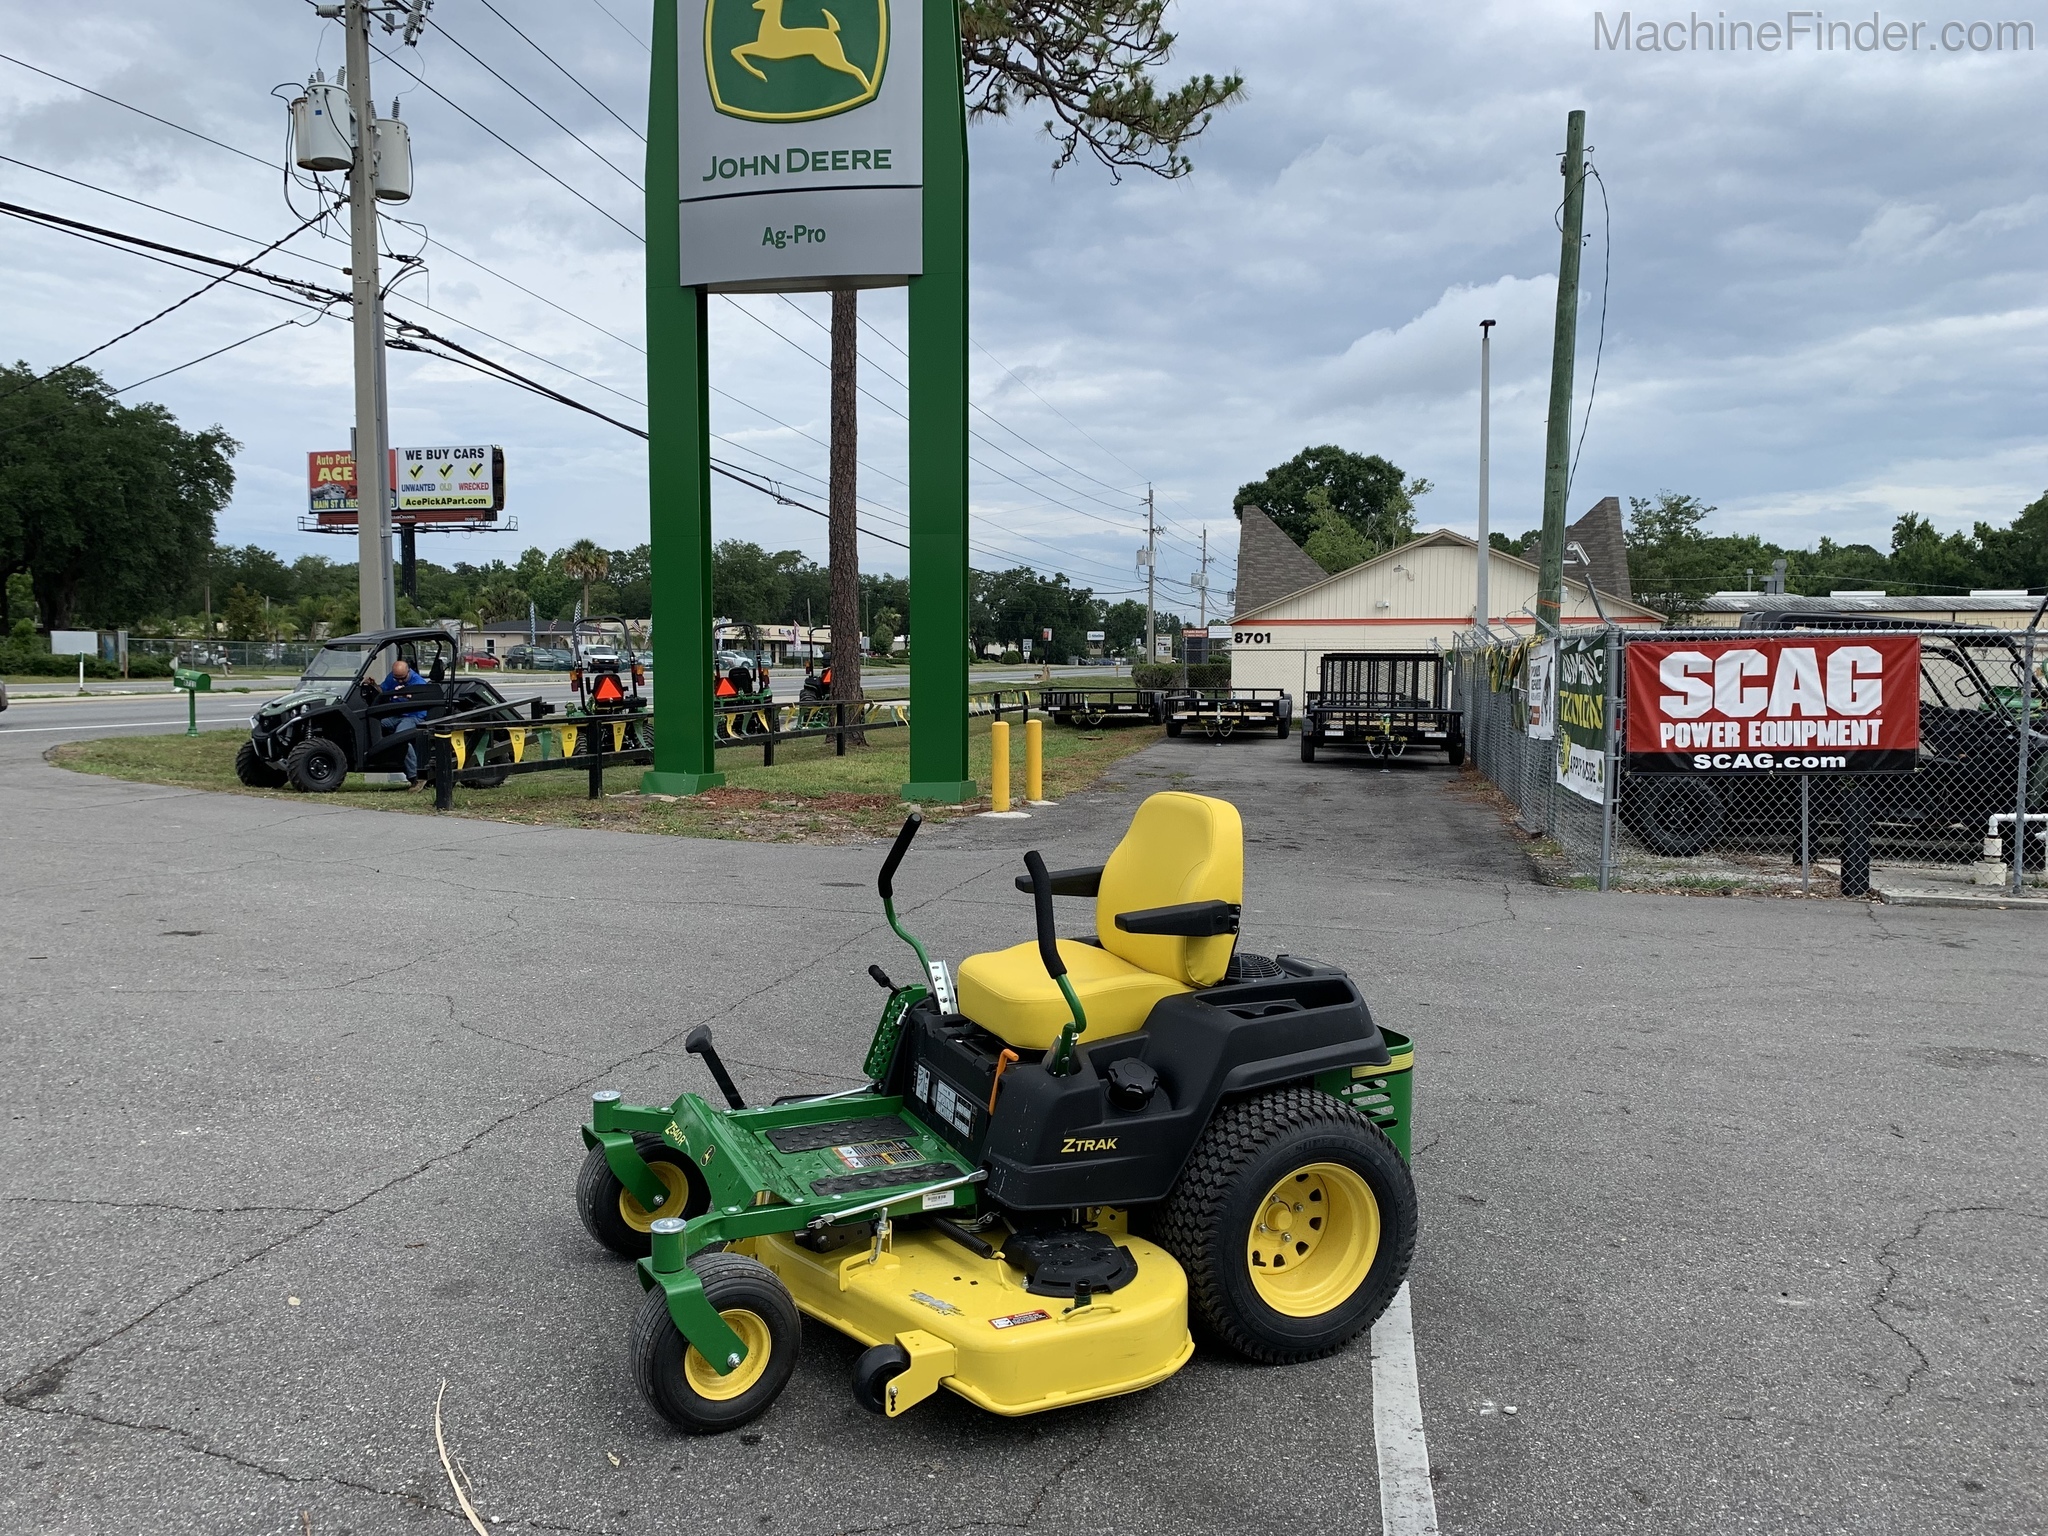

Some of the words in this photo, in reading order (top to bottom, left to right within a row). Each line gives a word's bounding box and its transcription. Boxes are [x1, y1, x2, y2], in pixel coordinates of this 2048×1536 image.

[702, 153, 780, 182] JOHN
[786, 147, 892, 173] DEERE
[761, 224, 827, 249] Ag-Pro
[316, 454, 333, 465] Auto
[405, 449, 422, 460] WE
[426, 449, 449, 460] BUY
[453, 448, 485, 459] CARS
[317, 466, 353, 481] ACE
[401, 483, 436, 492] UNWANTED
[439, 482, 452, 491] OLD
[458, 482, 490, 491] WRECKED
[313, 499, 329, 509] MAIN
[405, 497, 487, 506] AcePickAPart.com
[1234, 632, 1271, 643] 8701
[1659, 646, 1883, 718] SCAG
[1660, 721, 1741, 749] POWER
[1748, 719, 1883, 747] EQUIPMENT
[1693, 753, 1846, 769] SCAG.com
[1060, 1137, 1119, 1153] ZTRAK
